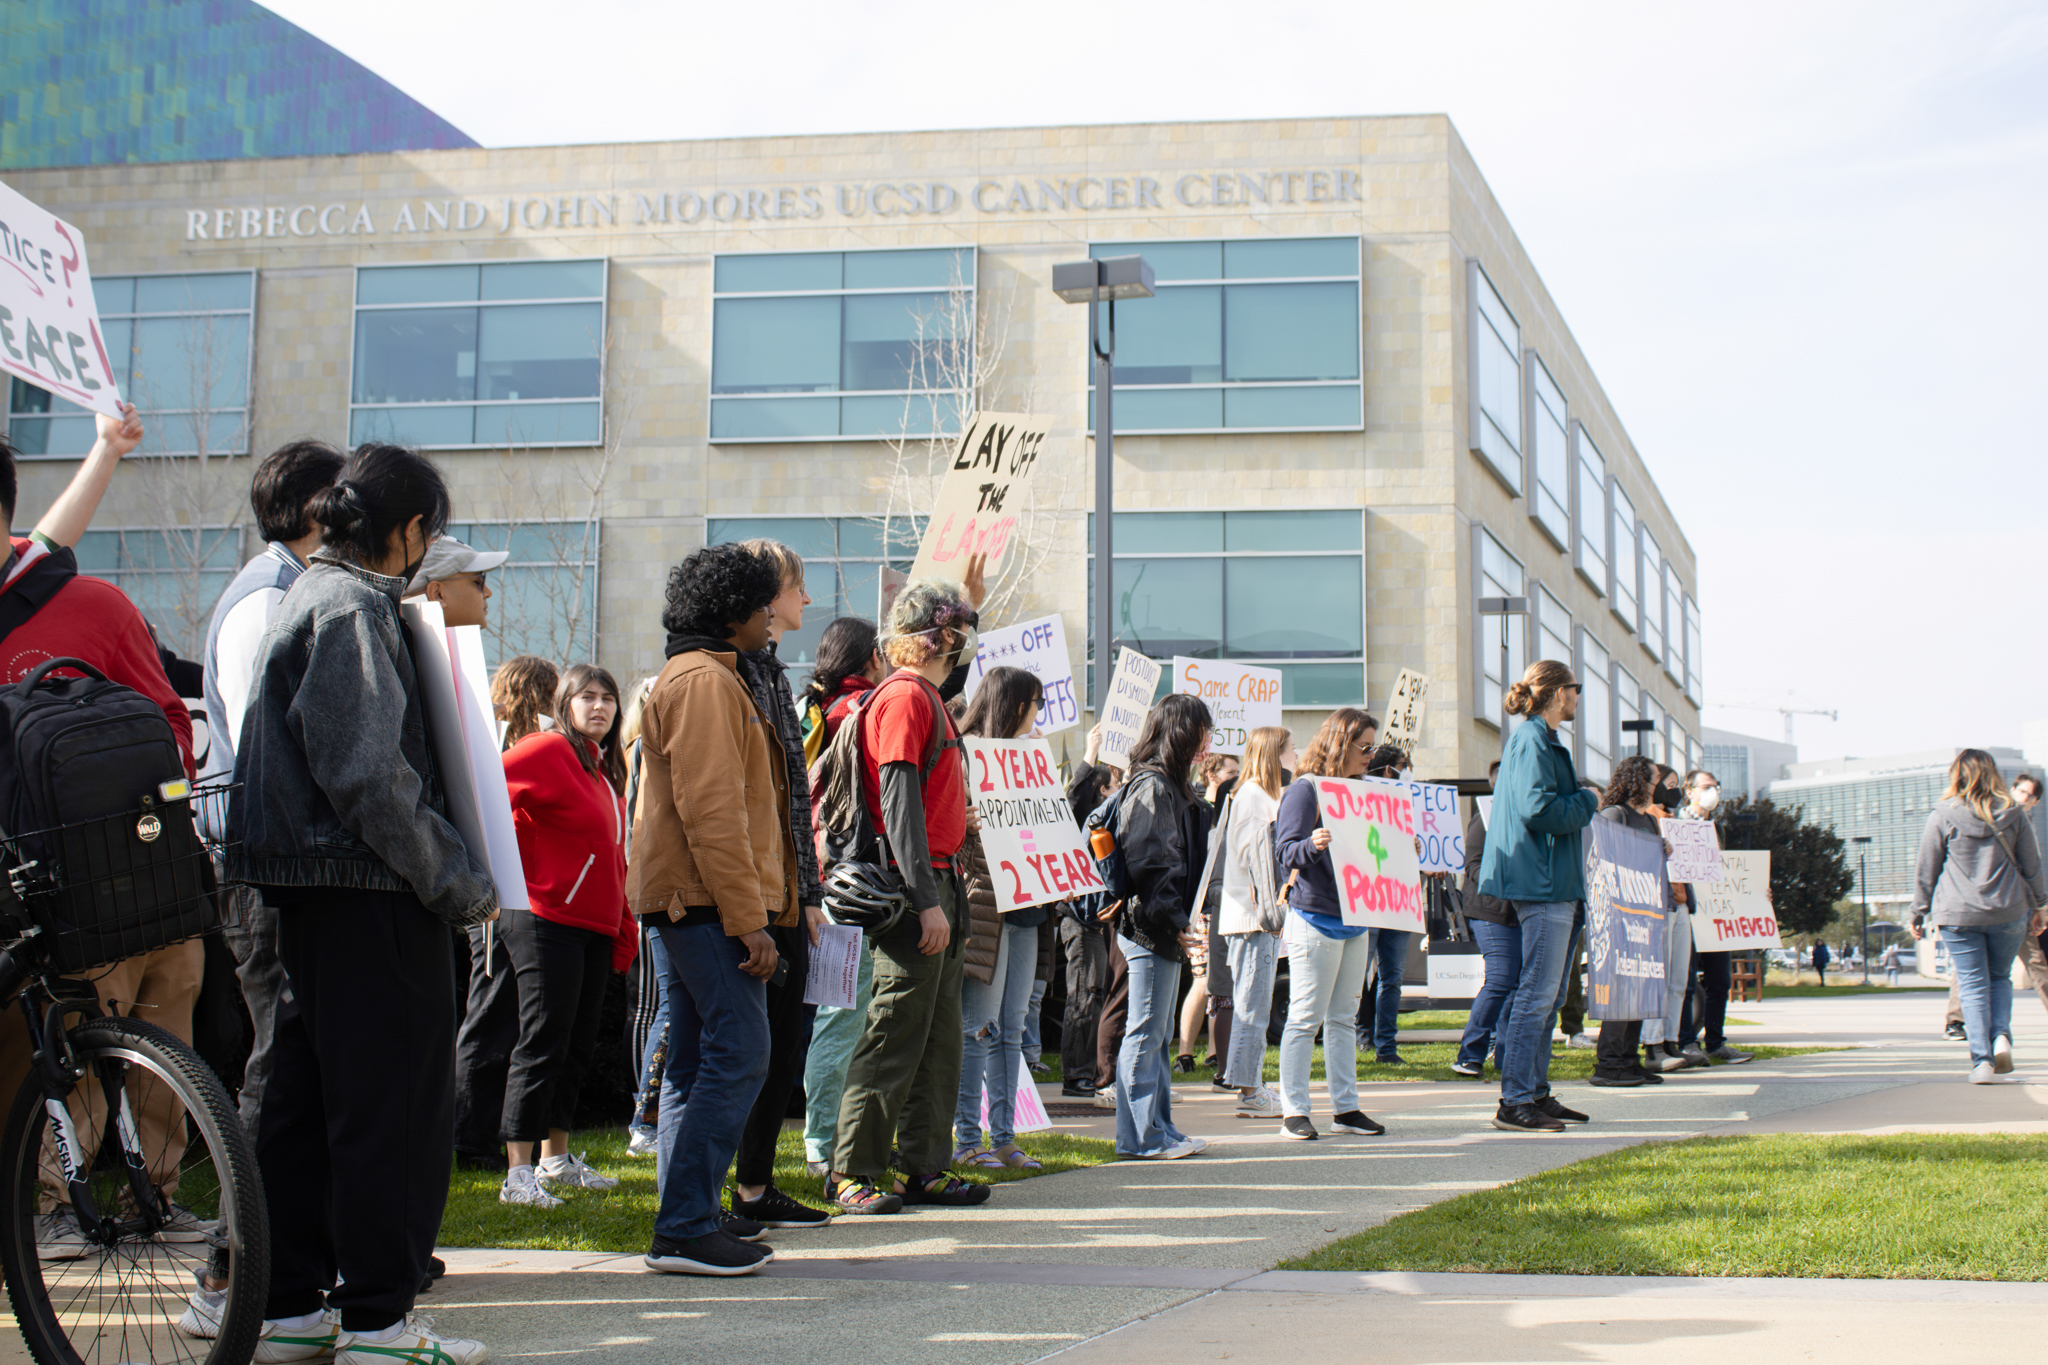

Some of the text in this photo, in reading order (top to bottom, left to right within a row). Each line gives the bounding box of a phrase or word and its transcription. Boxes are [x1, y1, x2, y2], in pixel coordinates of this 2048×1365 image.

[185, 169, 1364, 241] REBECCA AND JOHN MOORES UCSD CANCER CENTER
[954, 422, 1045, 478] LAY OFF
[976, 483, 1010, 513] THE
[1021, 622, 1053, 652] OFF
[1124, 653, 1157, 688] POSTDOCS
[1398, 673, 1406, 697] 2
[1238, 674, 1279, 703] CRAP
[1205, 700, 1245, 728] fferent
[1391, 709, 1399, 728] 2
[1211, 727, 1247, 747] STD
[974, 748, 1055, 792] 2 YEAR
[979, 797, 1073, 829] APPOINTMENT
[1320, 780, 1415, 836] JUSTICE
[137, 822, 161, 835] WALD
[1665, 821, 1712, 843] PROTECT
[1000, 848, 1104, 905] 2 YEAR
[1673, 862, 1722, 882] SCHOLARS
[1713, 916, 1776, 941] THIEVED
[1435, 971, 1446, 980] UC
[1446, 971, 1459, 980] San
